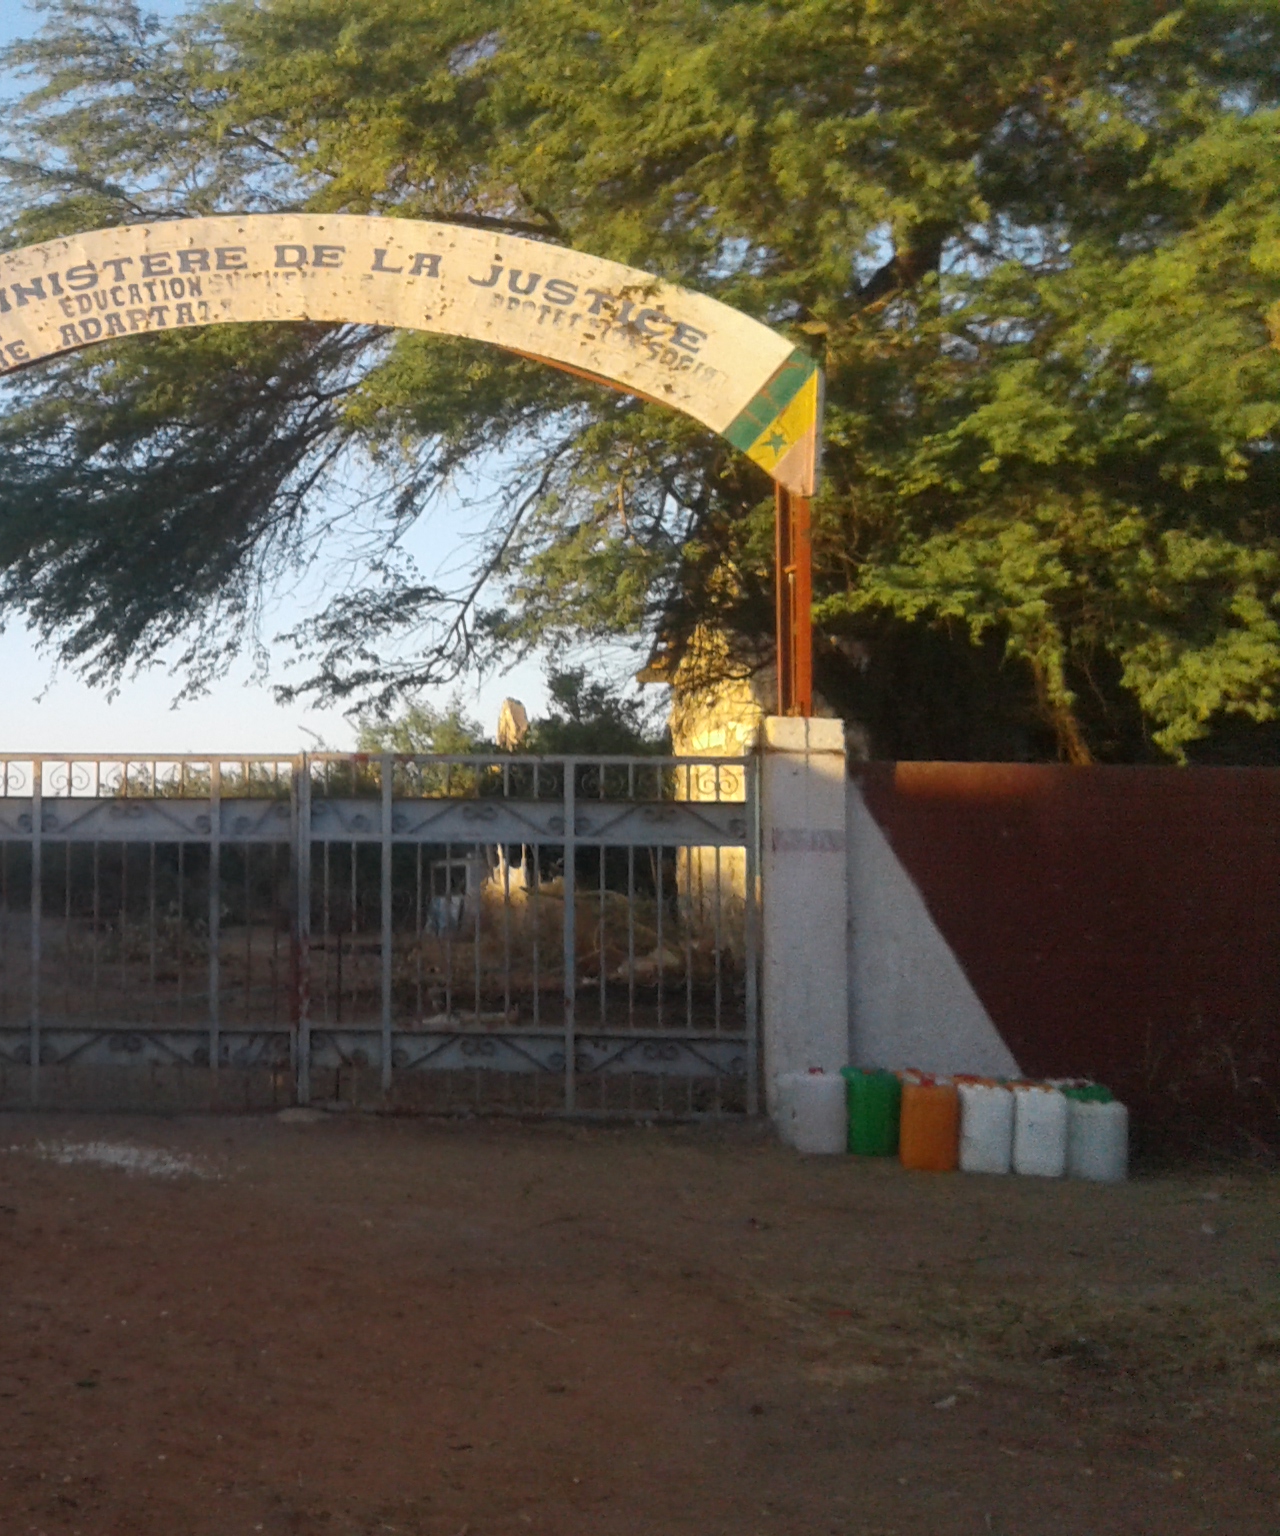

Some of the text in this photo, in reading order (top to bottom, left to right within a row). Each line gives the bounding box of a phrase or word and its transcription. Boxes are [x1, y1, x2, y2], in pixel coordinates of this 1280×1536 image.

[58, 276, 202, 318] EDUCATION
[274, 244, 346, 268] DE
[371, 248, 442, 278] LA
[468, 264, 708, 353] JUSTICE
